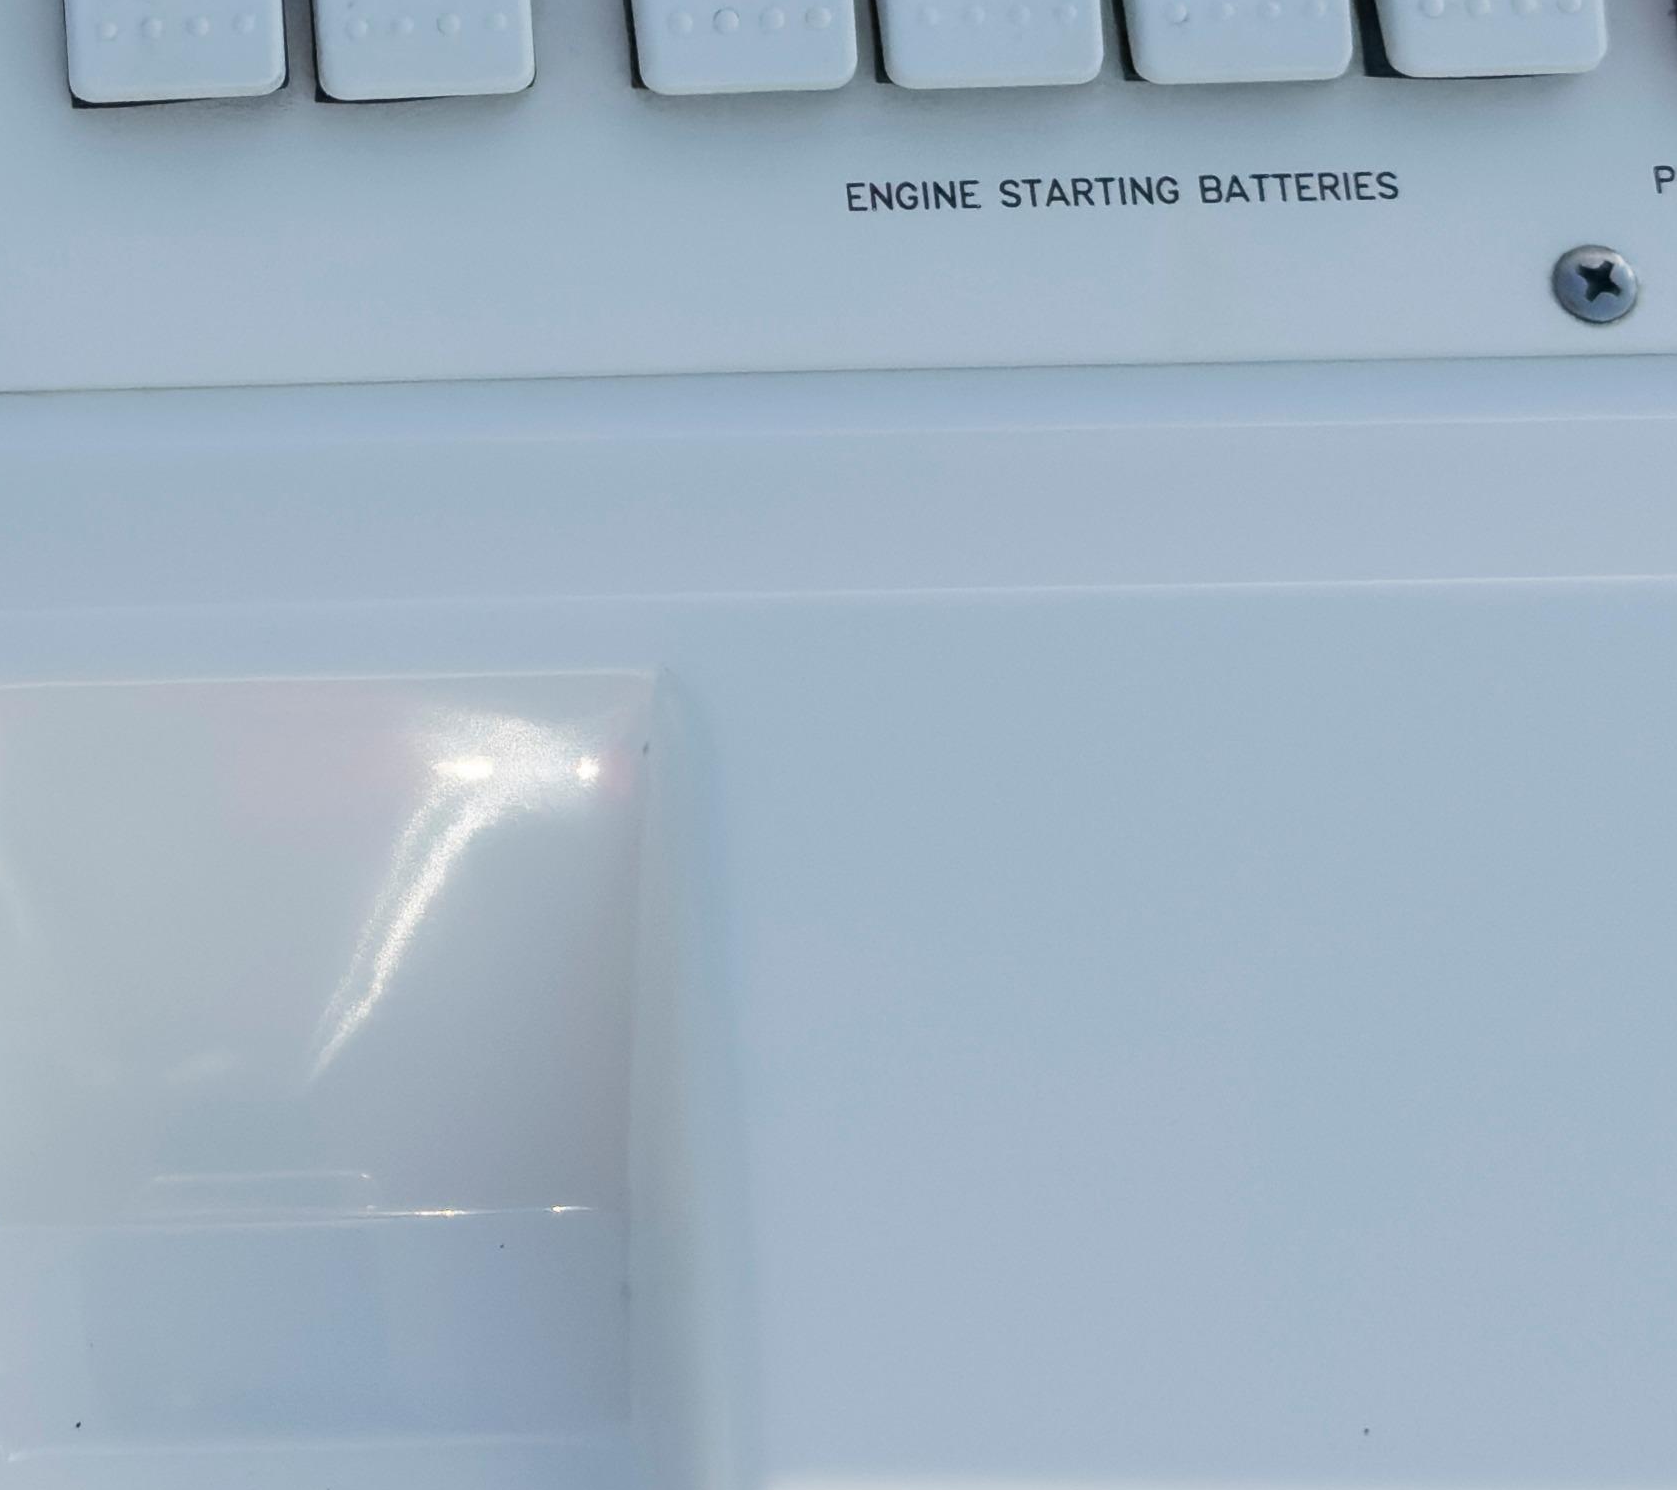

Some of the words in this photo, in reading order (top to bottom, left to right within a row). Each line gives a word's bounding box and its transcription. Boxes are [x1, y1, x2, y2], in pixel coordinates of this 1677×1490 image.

[845, 178, 983, 213] ENGINE
[998, 174, 1181, 209] STARTING
[1197, 170, 1400, 205] BATTERIES
